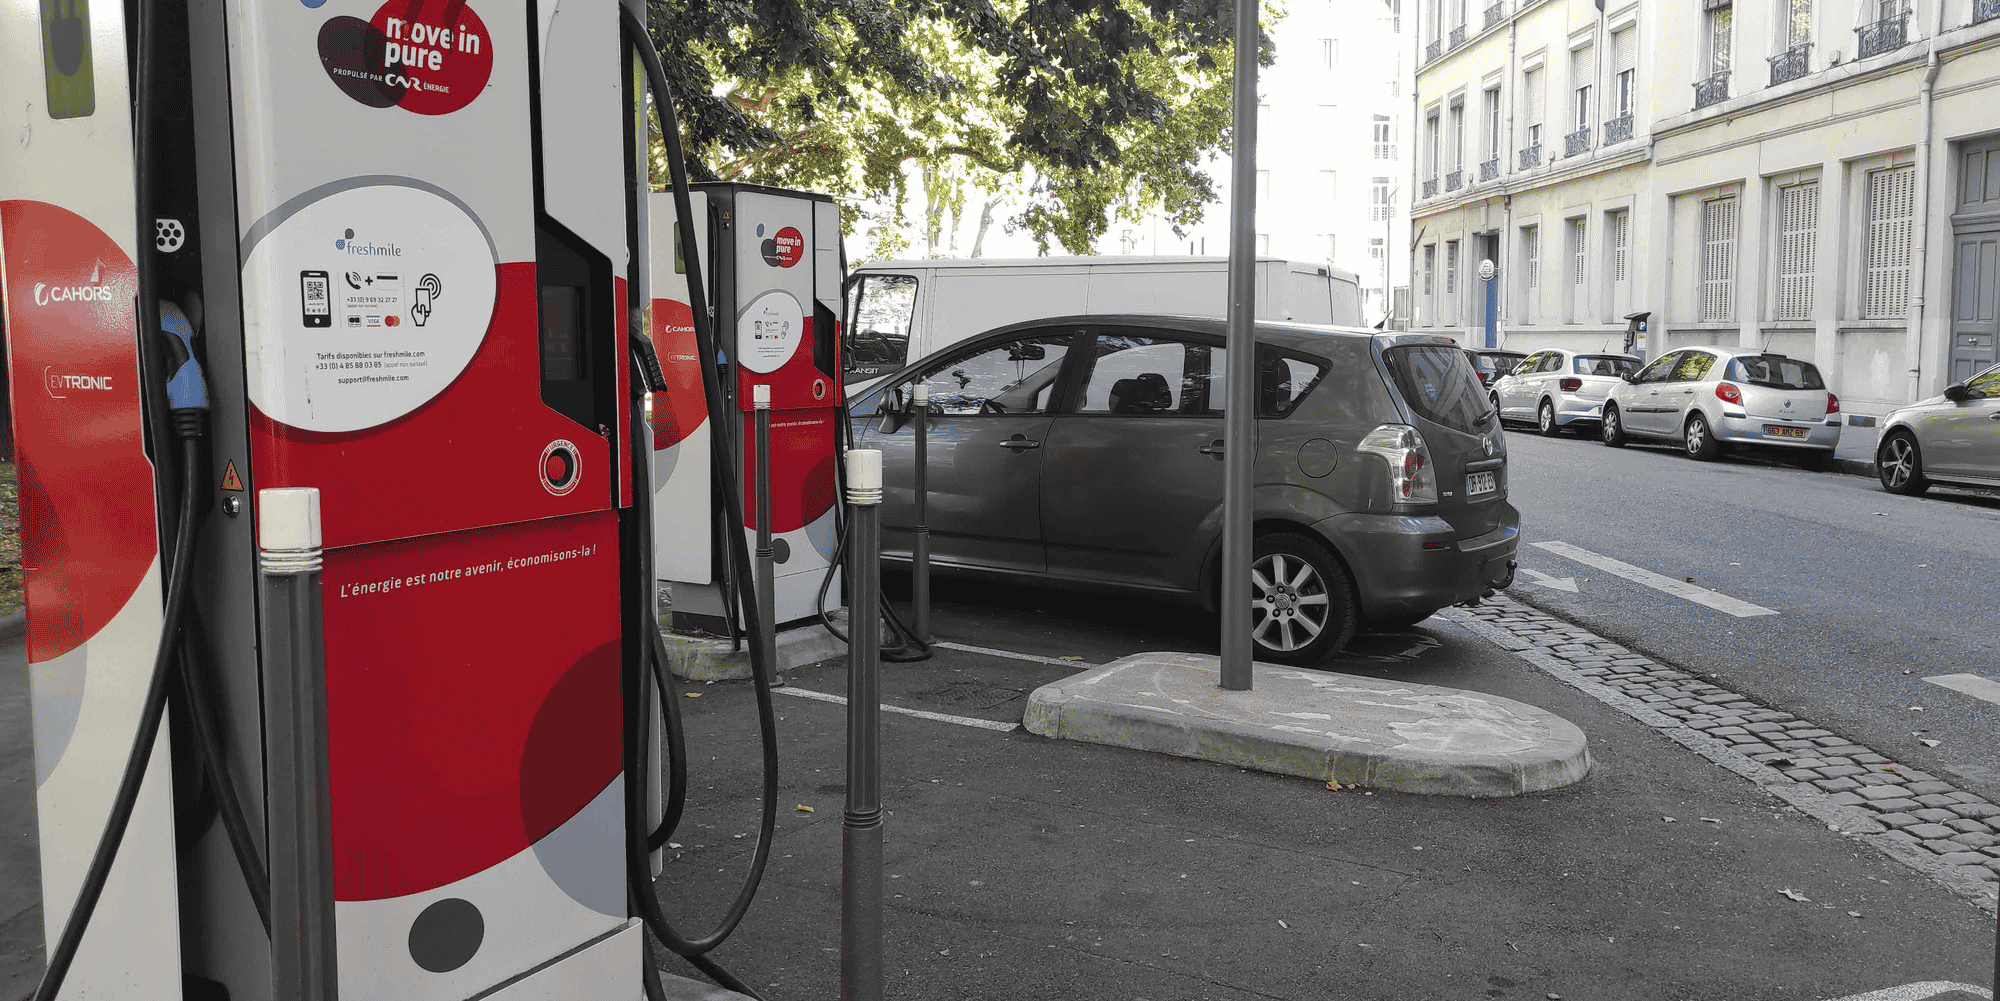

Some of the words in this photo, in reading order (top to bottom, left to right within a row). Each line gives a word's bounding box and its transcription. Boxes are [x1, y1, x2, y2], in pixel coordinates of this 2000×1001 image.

[386, 17, 454, 49] move
[458, 24, 480, 54] in
[384, 41, 443, 71] pure
[333, 67, 368, 80] PROPULSÉ
[369, 73, 383, 82] PAR
[423, 82, 450, 94] ÉNERGIE
[346, 240, 402, 257] freshmile
[775, 245, 792, 254] pure
[776, 237, 794, 246] move
[794, 236, 801, 247] in
[50, 285, 113, 302] CAHORS
[1640, 321, 1646, 330] P
[317, 352, 335, 360] Tarifs
[336, 351, 372, 360] disponibles
[383, 350, 425, 358] freshmile.com
[329, 362, 338, 370] (0)
[50, 374, 113, 390] EVTRONIC
[338, 374, 410, 384] support@freshmile.com
[340, 576, 402, 598] L'énergie
[405, 573, 427, 587] est
[429, 568, 462, 584] notre
[464, 559, 504, 577] avenir,
[506, 545, 591, 570] économisons-la
[592, 543, 597, 555] !
